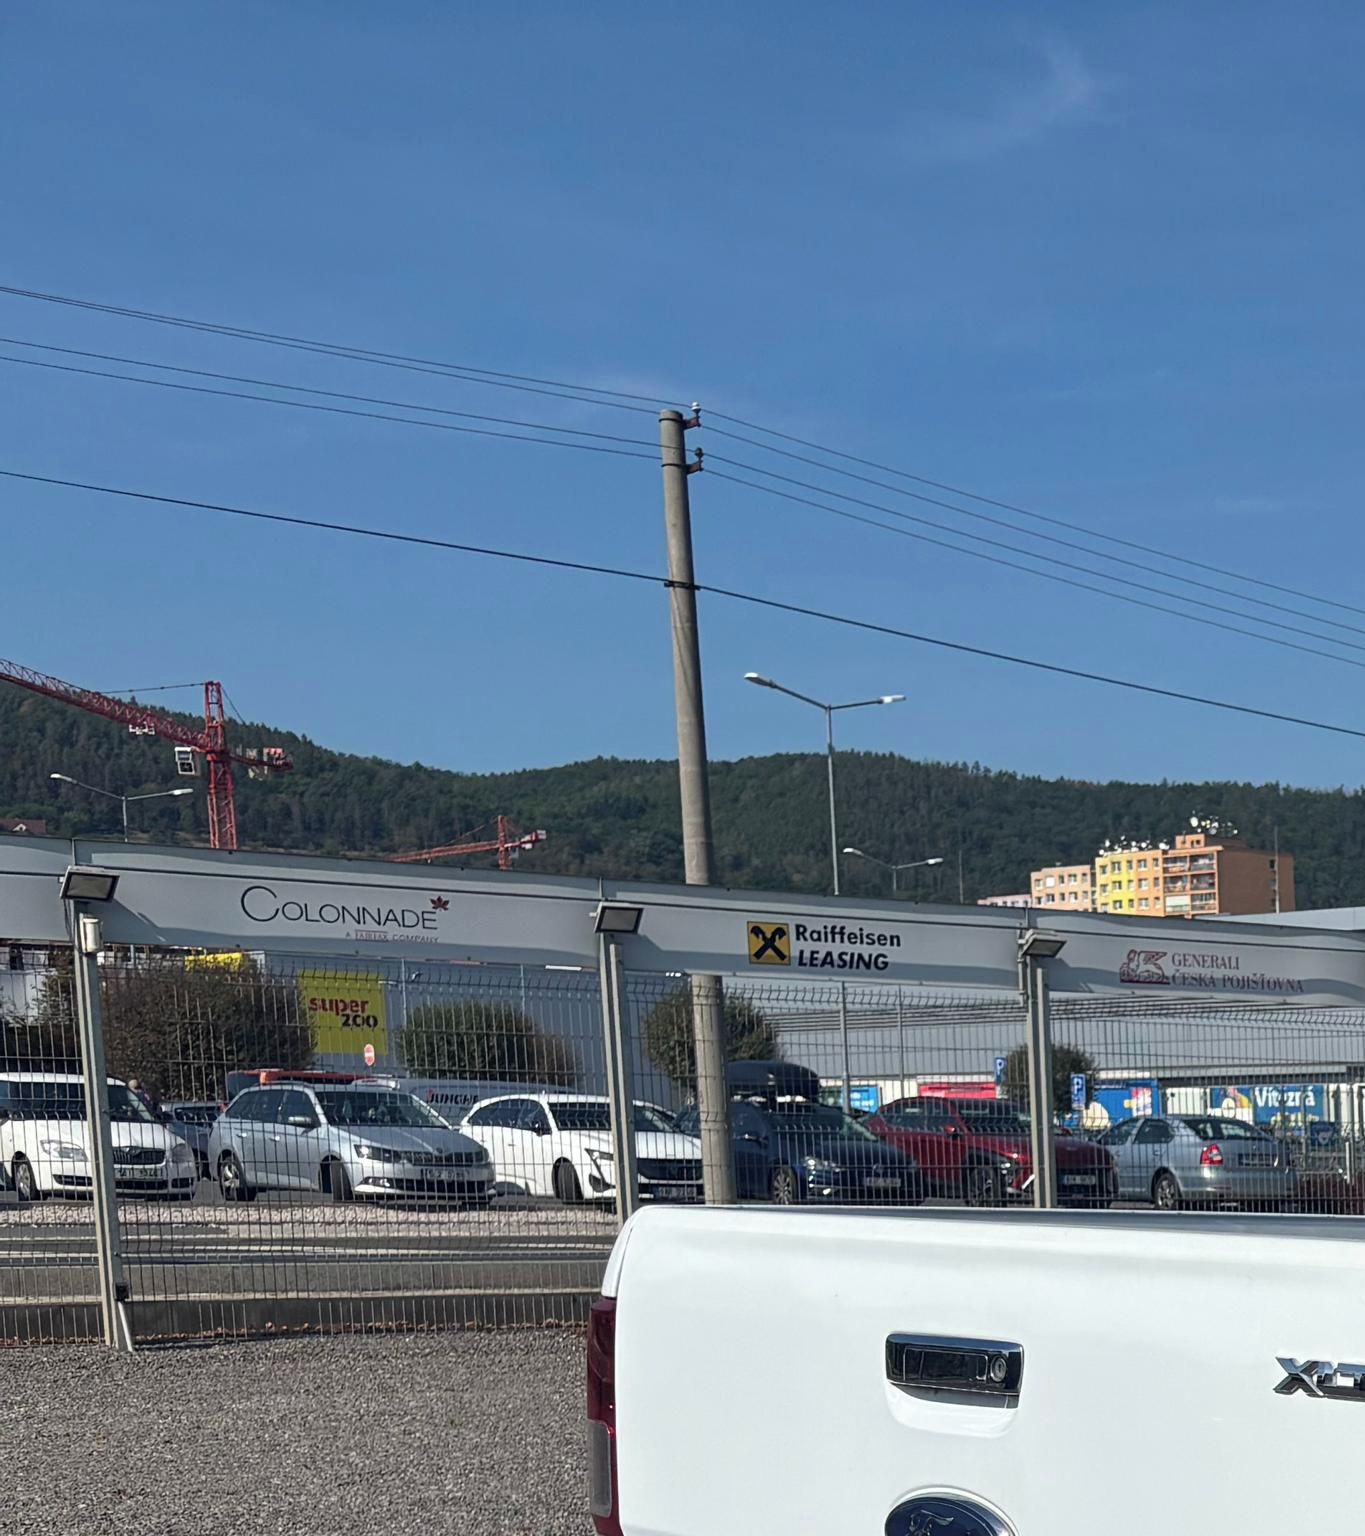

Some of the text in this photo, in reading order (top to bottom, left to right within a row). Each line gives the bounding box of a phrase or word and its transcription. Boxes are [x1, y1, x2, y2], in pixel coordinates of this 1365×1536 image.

[241, 885, 438, 930] COLONNADE
[795, 924, 901, 947] Raiffeisen
[798, 949, 889, 971] LEASING
[1172, 952, 1240, 970] GENERALI
[1171, 969, 1304, 993] ČESKÁ POJIŠŤOVNA
[1073, 1077, 1082, 1094] P
